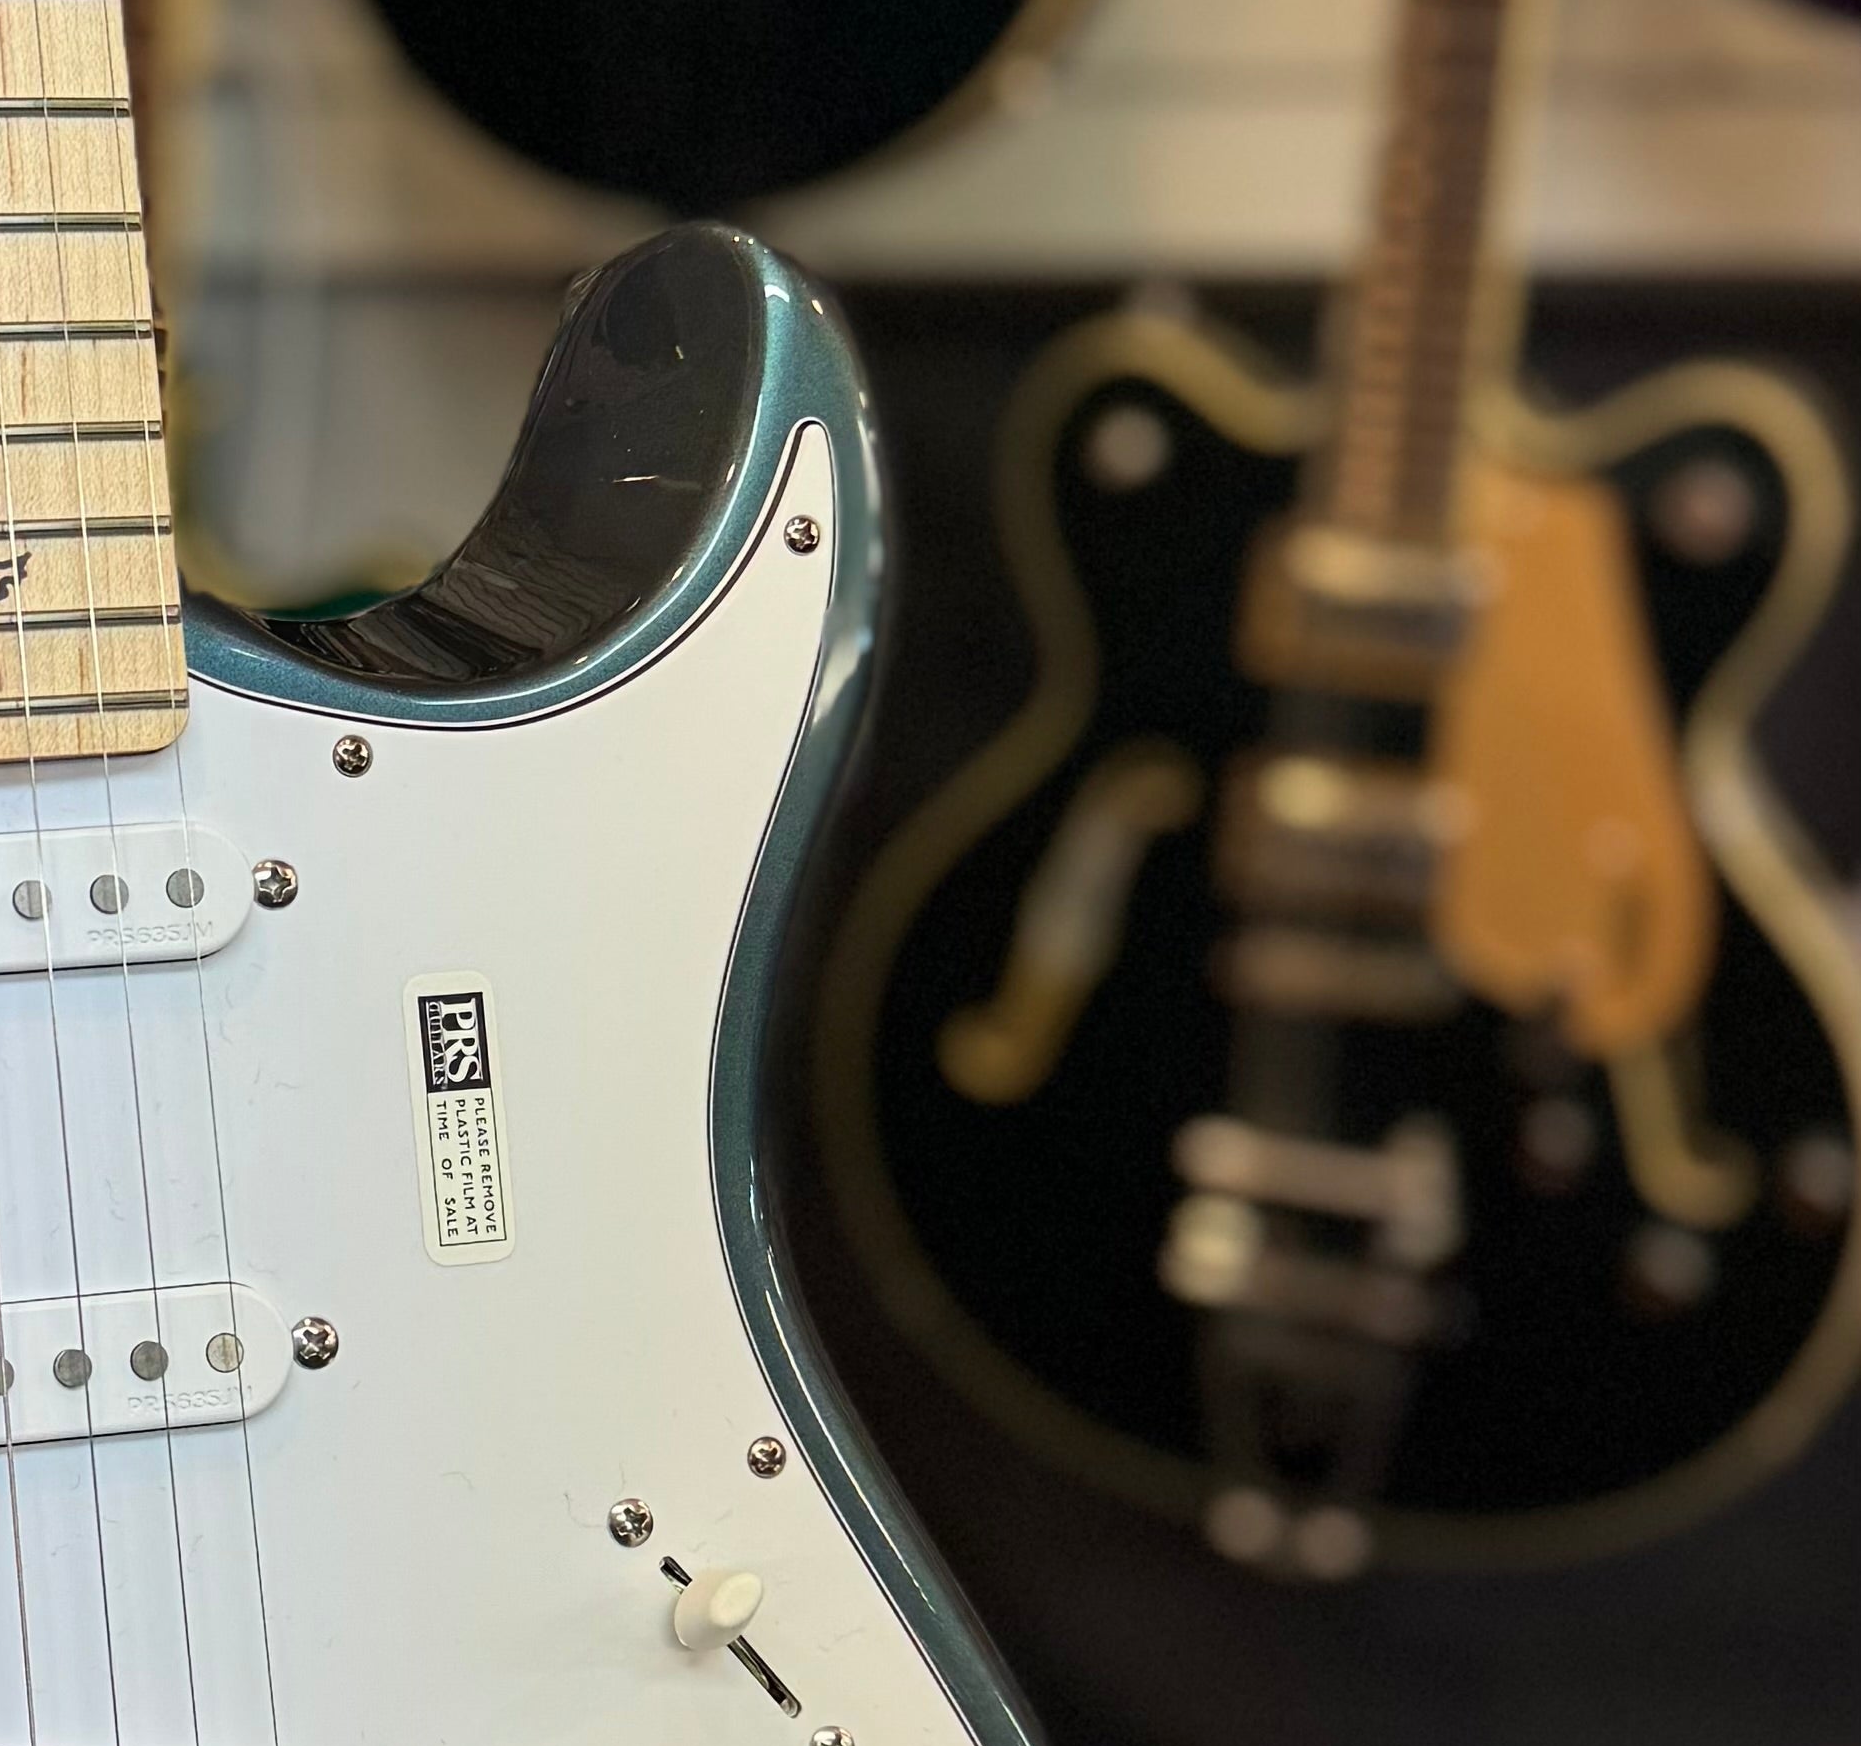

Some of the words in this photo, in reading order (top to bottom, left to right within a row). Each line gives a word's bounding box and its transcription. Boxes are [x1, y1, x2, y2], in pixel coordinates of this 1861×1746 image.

[440, 998, 483, 1083] PRS
[436, 1100, 450, 1141] TIME
[455, 1098, 472, 1166] PLASTIC
[474, 1097, 490, 1157] PLEASE
[441, 1158, 453, 1180] OF
[461, 1172, 476, 1210] FILM
[480, 1163, 497, 1233] REMOVE
[444, 1197, 459, 1237] SALE
[466, 1216, 478, 1235] AT
